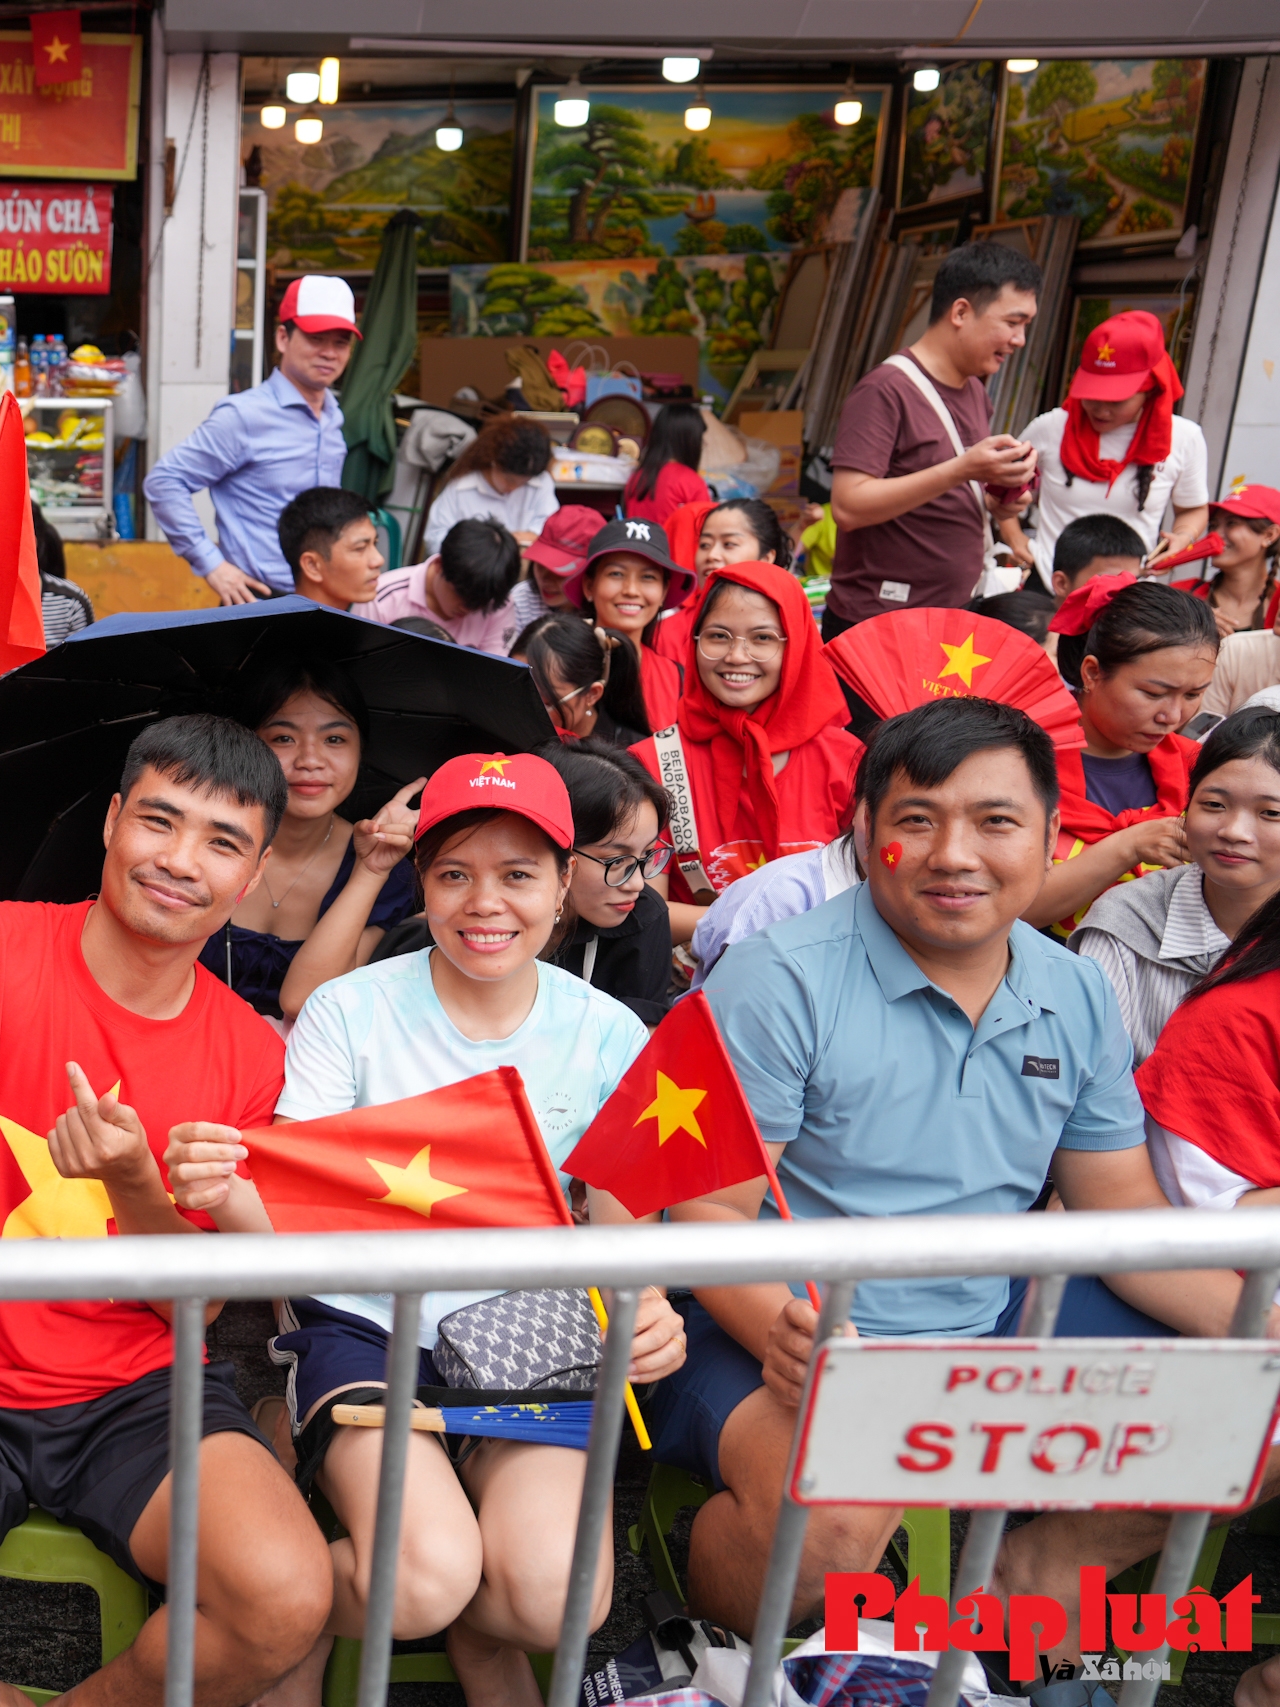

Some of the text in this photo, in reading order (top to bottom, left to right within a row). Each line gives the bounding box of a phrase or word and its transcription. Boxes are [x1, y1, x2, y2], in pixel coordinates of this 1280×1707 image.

[0, 58, 36, 95] XÂY
[46, 185, 101, 234] CHẢ
[45, 240, 104, 283] SƯỜN
[922, 678, 951, 697] VIỆT
[469, 775, 516, 790] VIỆT NAM
[944, 1362, 1156, 1396] POLICE
[896, 1421, 1172, 1475] STOP
[594, 1671, 609, 1700] GAOJI
